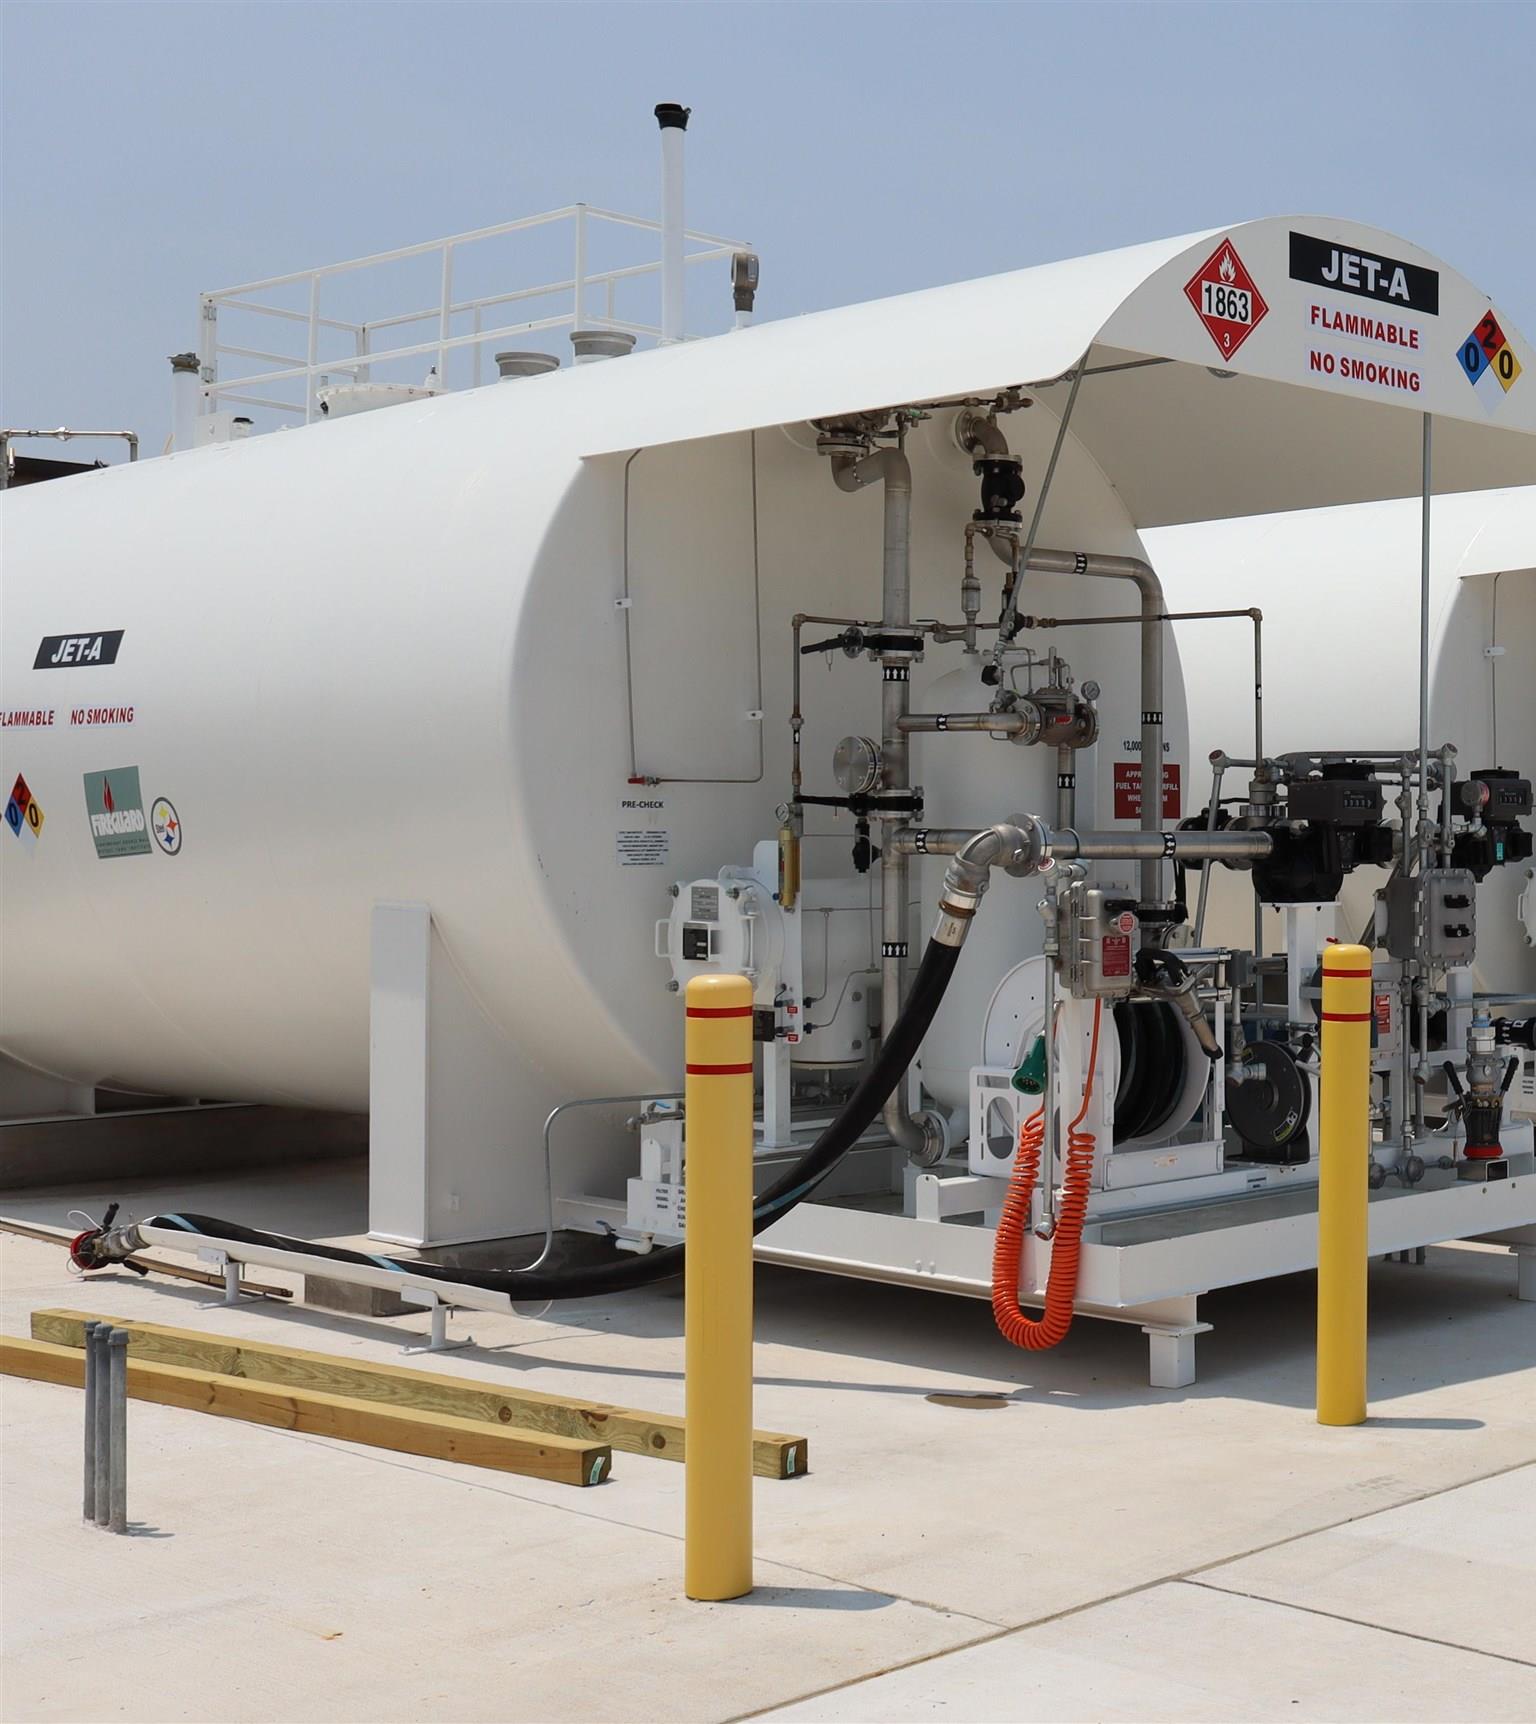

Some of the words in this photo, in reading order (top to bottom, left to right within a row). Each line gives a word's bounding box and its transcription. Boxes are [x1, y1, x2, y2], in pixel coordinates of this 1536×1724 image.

[1321, 249, 1410, 301] JET-A
[1204, 284, 1249, 323] 1863
[1224, 333, 1231, 348] 3
[1310, 305, 1419, 350] FLAMMABLE
[1482, 319, 1497, 349] 2
[1310, 350, 1335, 375] NO
[1340, 357, 1420, 393] SMOKING
[1464, 342, 1479, 373] 0
[1499, 349, 1513, 379] 0
[51, 636, 103, 663] JET-A
[71, 709, 85, 725] NO
[87, 707, 134, 724] SMOKING
[1116, 782, 1131, 790] FUEL
[8, 802, 18, 827] 0
[28, 803, 38, 828] 0
[621, 800, 664, 809] PRE-CHECK
